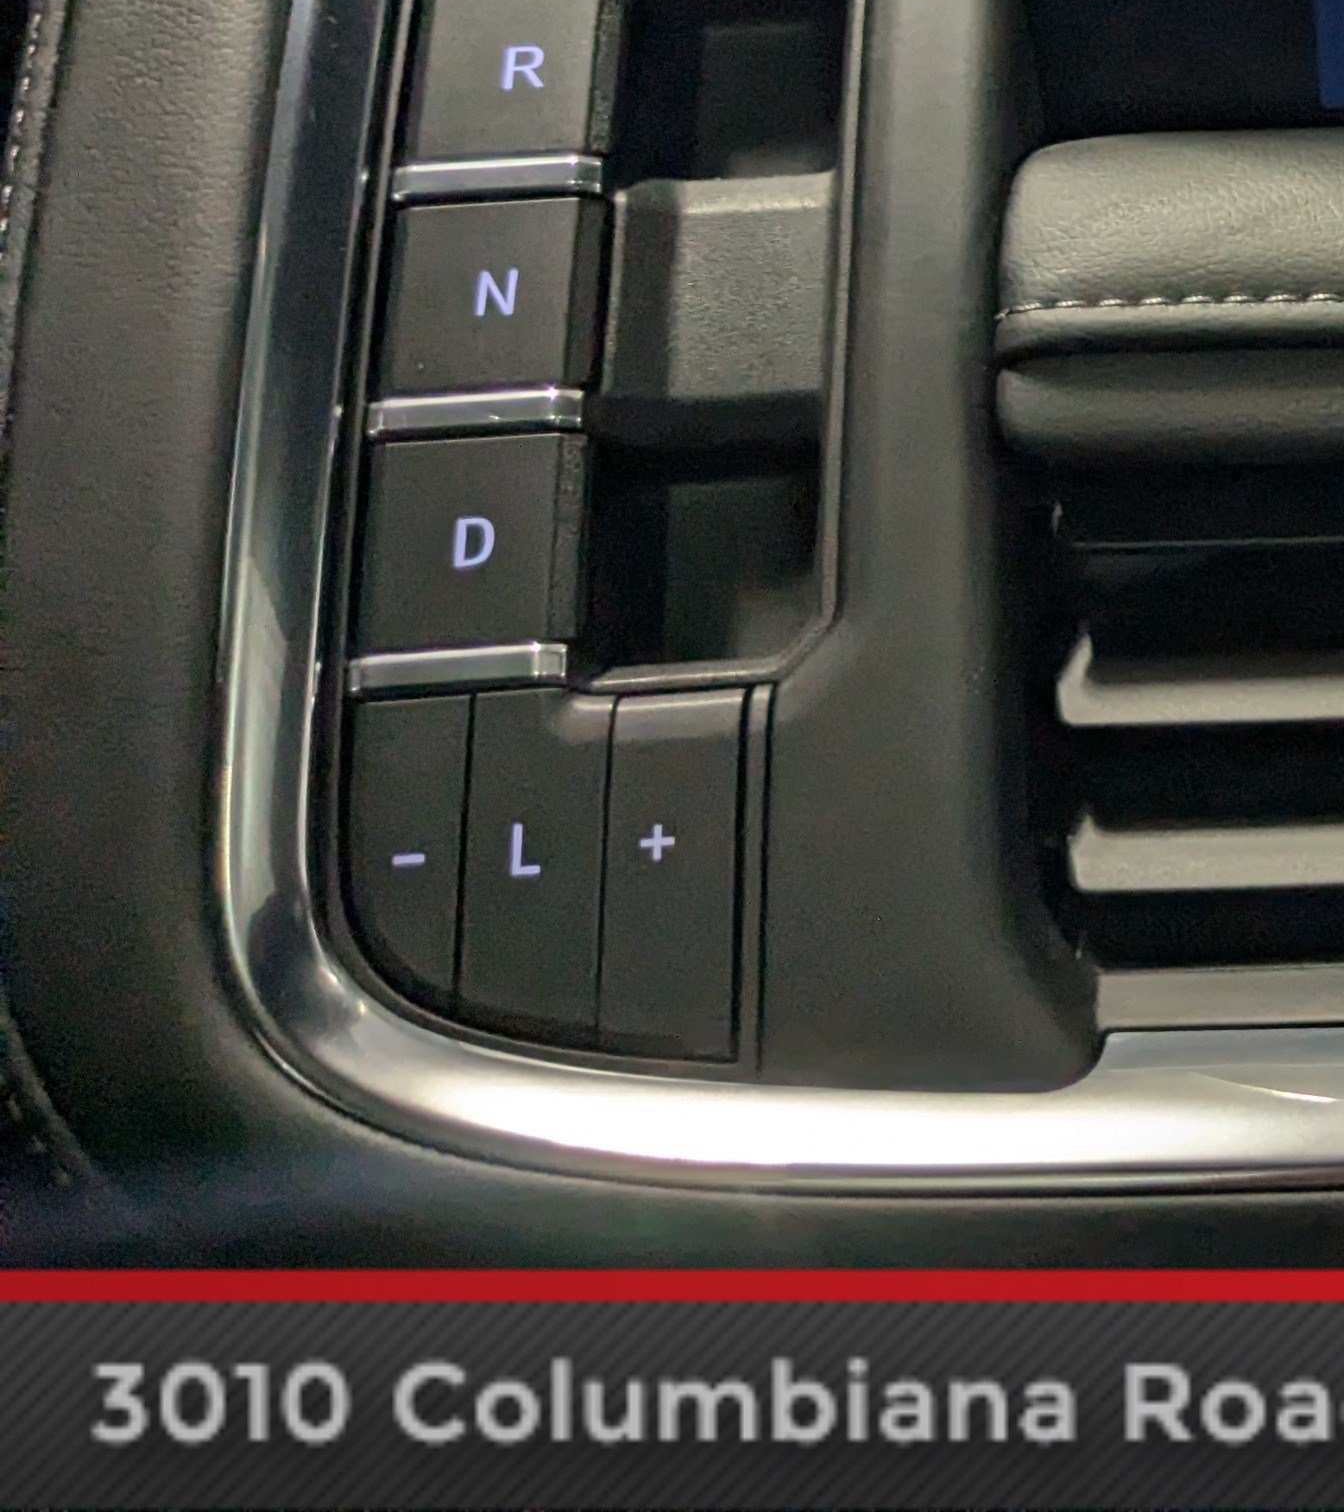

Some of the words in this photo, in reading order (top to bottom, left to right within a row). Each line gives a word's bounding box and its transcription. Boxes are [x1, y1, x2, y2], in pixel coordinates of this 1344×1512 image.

[501, 45, 546, 90] R
[474, 267, 520, 318] N
[451, 516, 496, 570] D
[509, 822, 542, 878] L
